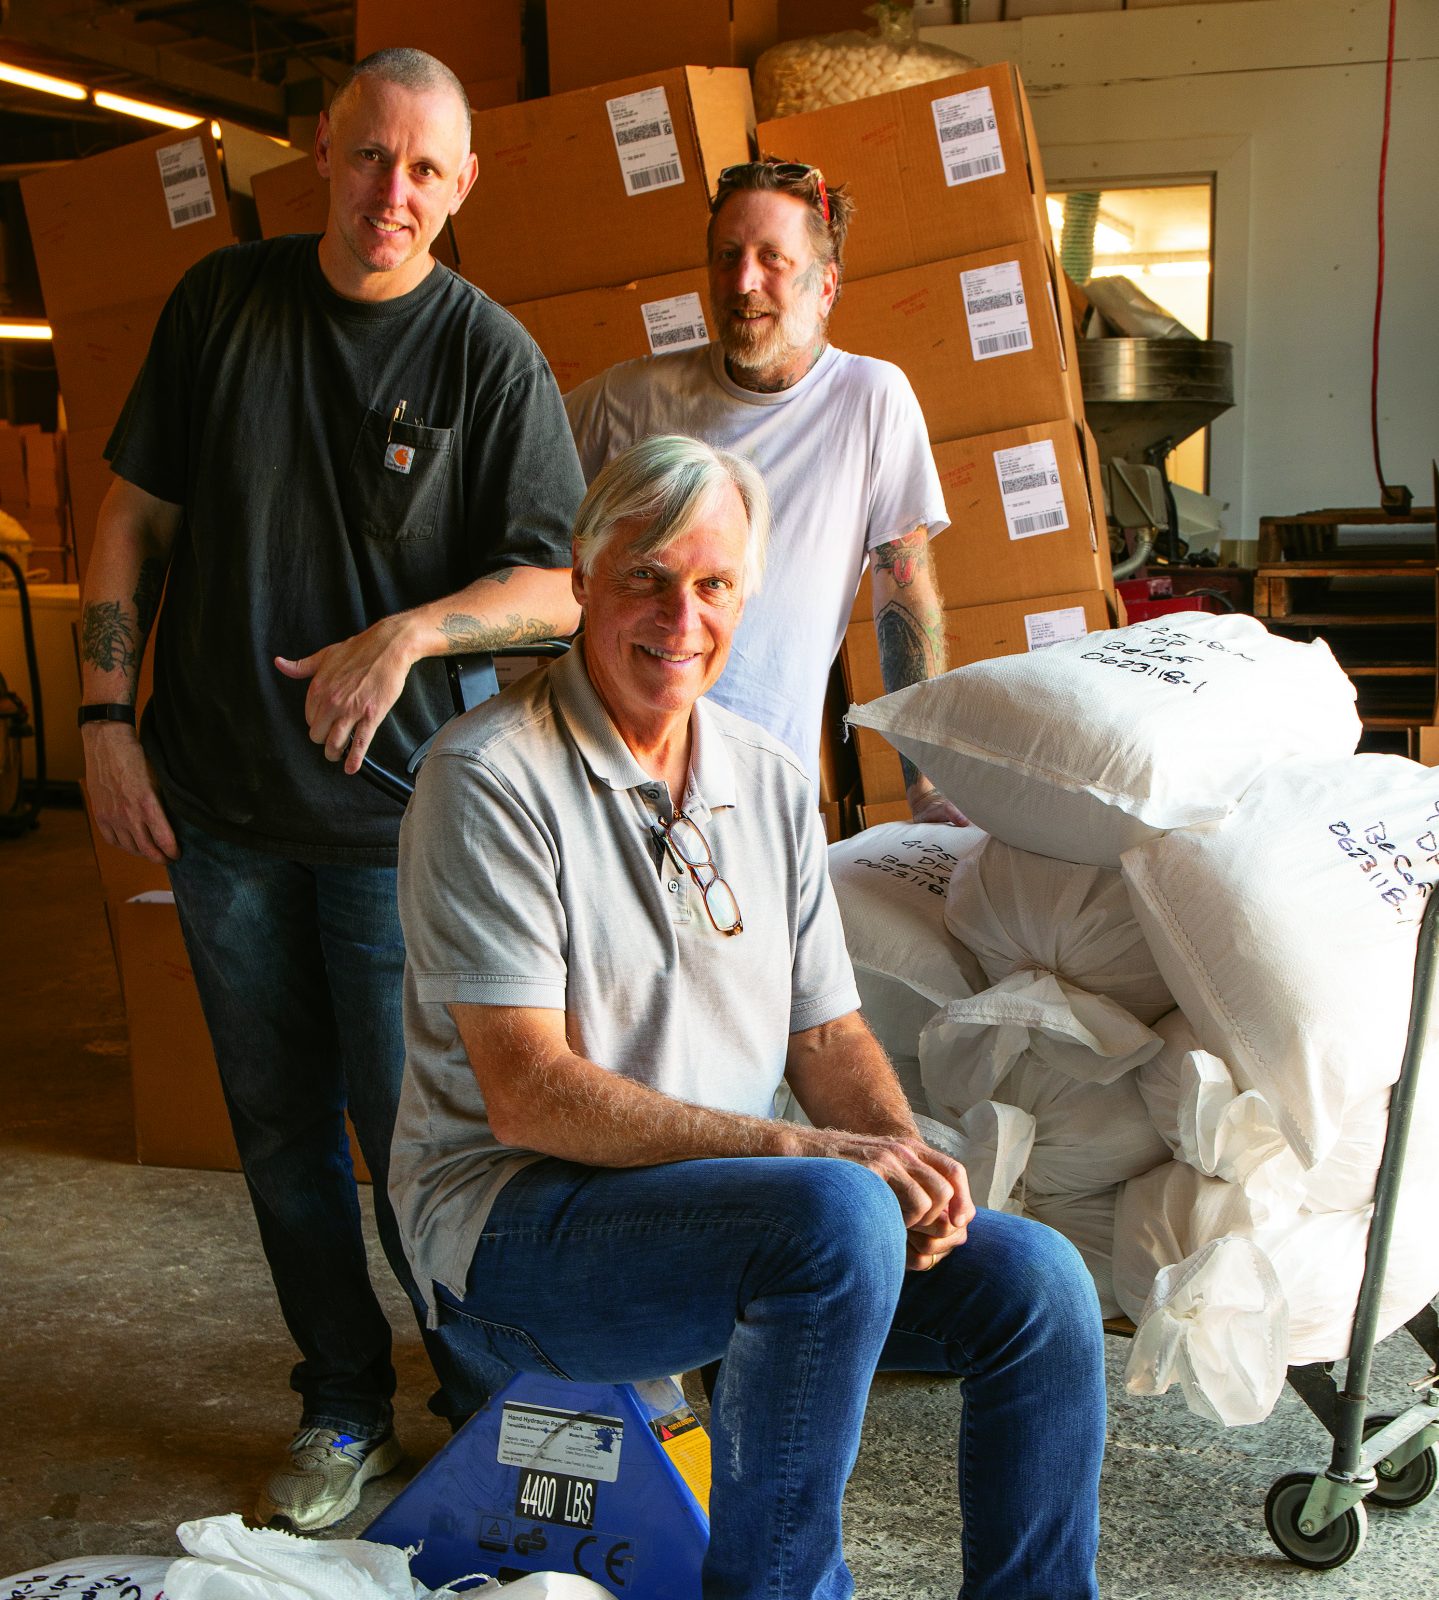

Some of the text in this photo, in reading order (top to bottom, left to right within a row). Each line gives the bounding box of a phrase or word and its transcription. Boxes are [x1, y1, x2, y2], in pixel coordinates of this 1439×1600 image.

[508, 1414, 523, 1422] Hand
[523, 1416, 550, 1427] Hydraulic
[520, 1473, 594, 1526] 4400 LBS
[574, 1536, 630, 1586] CE
